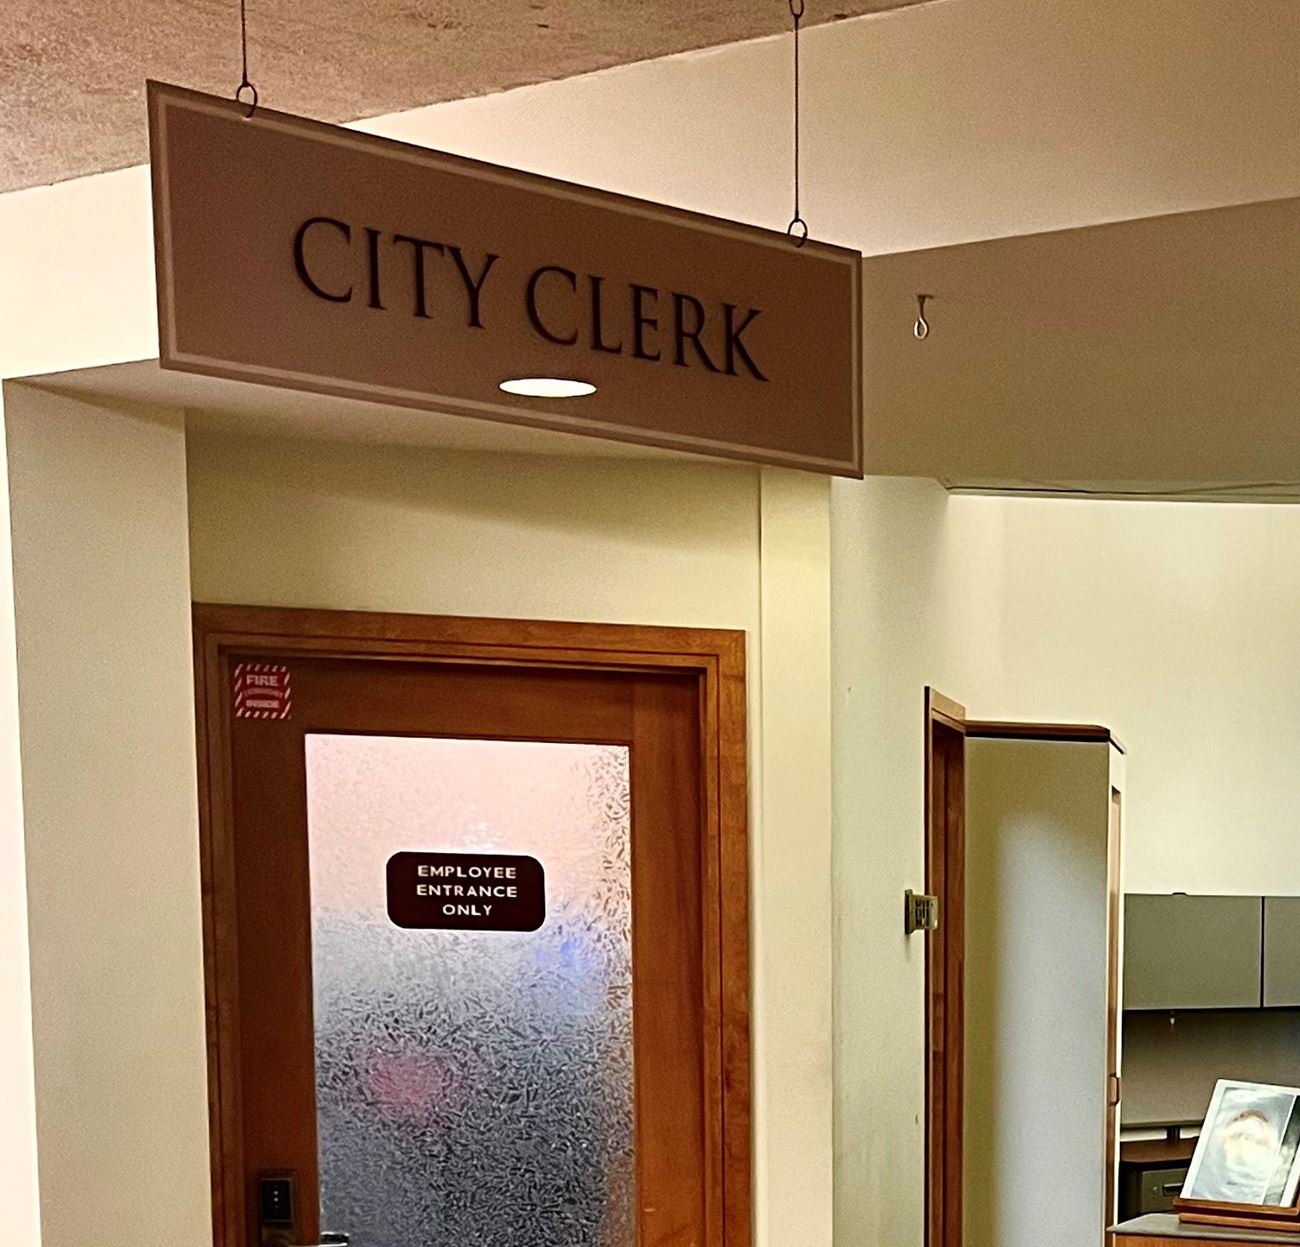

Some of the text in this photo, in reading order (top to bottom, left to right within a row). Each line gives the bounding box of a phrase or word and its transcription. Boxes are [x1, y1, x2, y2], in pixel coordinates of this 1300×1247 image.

[293, 216, 769, 382] CITY CLERK
[246, 675, 279, 687] FIRE
[417, 865, 517, 879] EMPLOYEE
[416, 884, 518, 898] ENTRANCE
[442, 904, 493, 916] ONLY
